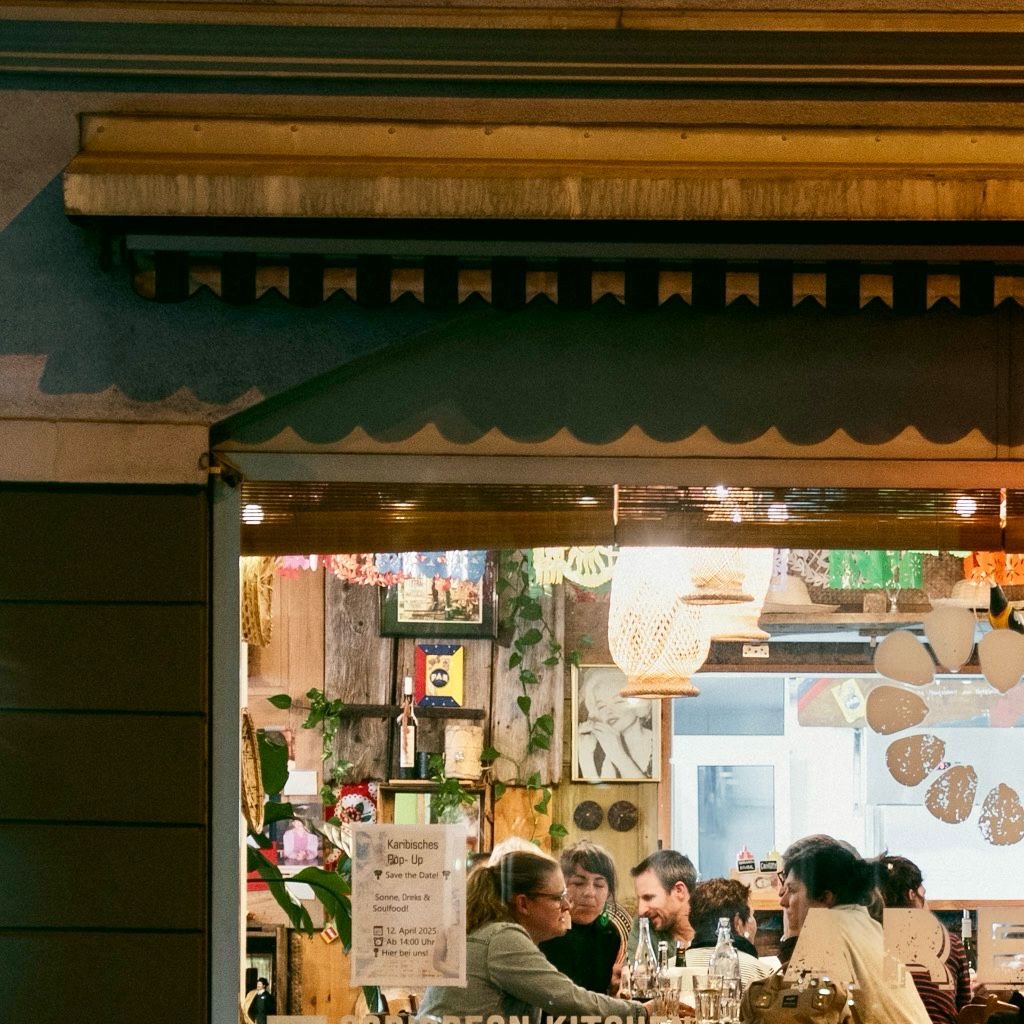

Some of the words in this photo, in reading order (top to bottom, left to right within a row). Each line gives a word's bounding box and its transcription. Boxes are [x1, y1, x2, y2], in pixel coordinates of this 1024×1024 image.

[387, 839, 439, 850] Karibisches
[411, 854, 424, 866] Up
[385, 871, 403, 879] Save
[404, 871, 417, 879] the
[419, 871, 439, 879] Date!
[402, 893, 422, 901] Drinks
[423, 893, 431, 901] &
[372, 904, 409, 913] Soulfood!
[386, 927, 397, 935] 12.
[398, 927, 417, 937] April
[418, 927, 437, 935] 2025
[386, 938, 398, 946] Ab
[399, 938, 420, 946] 14:00
[421, 938, 435, 946] Uhr
[381, 949, 398, 957] Hier
[399, 949, 411, 957] bei
[412, 949, 429, 957] uns!
